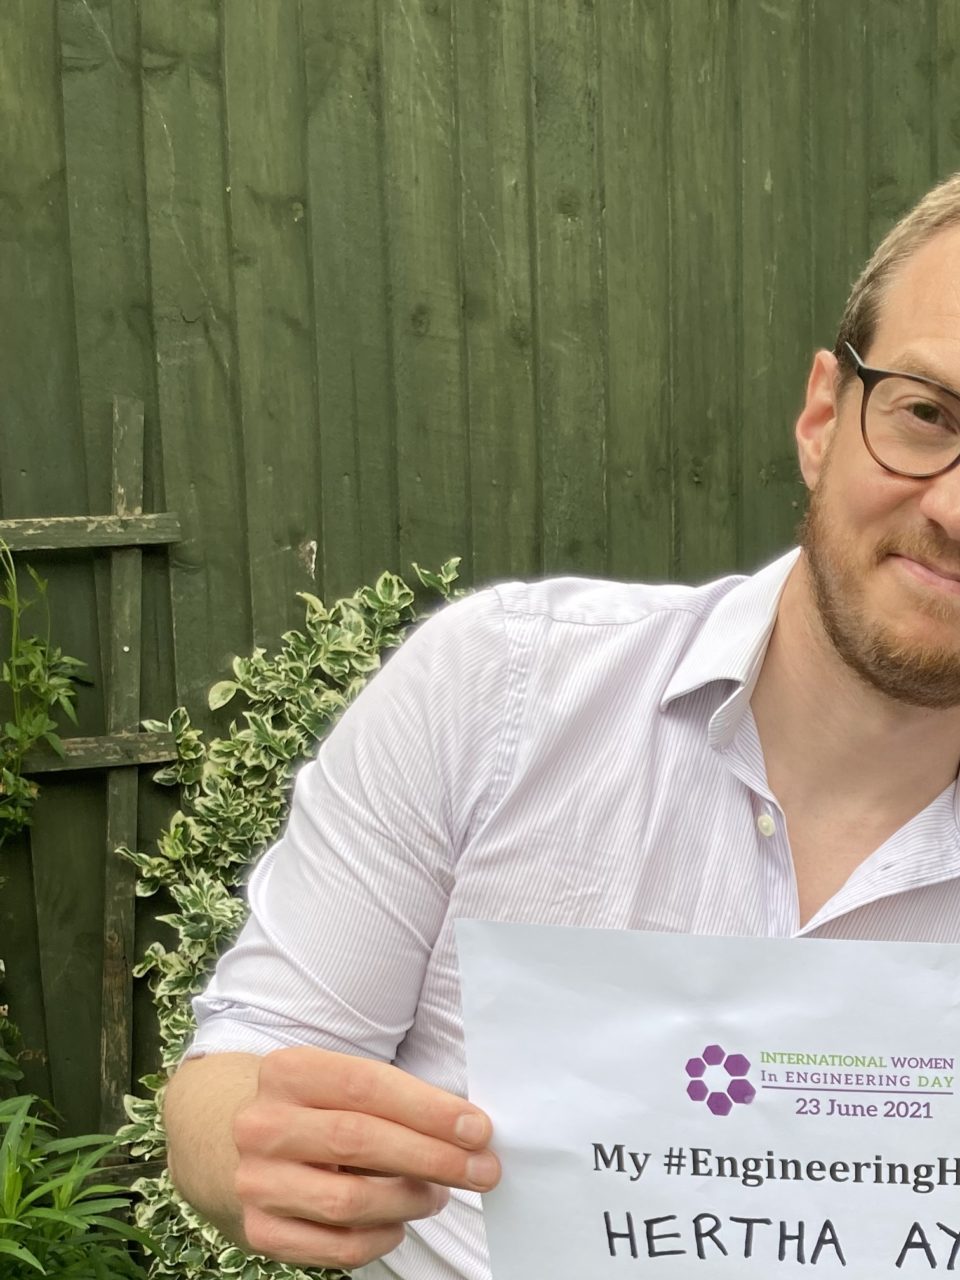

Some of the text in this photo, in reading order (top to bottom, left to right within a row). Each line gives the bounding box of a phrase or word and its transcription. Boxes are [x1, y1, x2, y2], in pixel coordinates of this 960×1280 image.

[761, 1052, 954, 1069] INTERNATIONAL WOMEN
[761, 1070, 954, 1087] In ENGINEERING DAY
[796, 1098, 933, 1118] 23 June 2021
[592, 1143, 651, 1181] My
[604, 1212, 846, 1266] HERTHA
